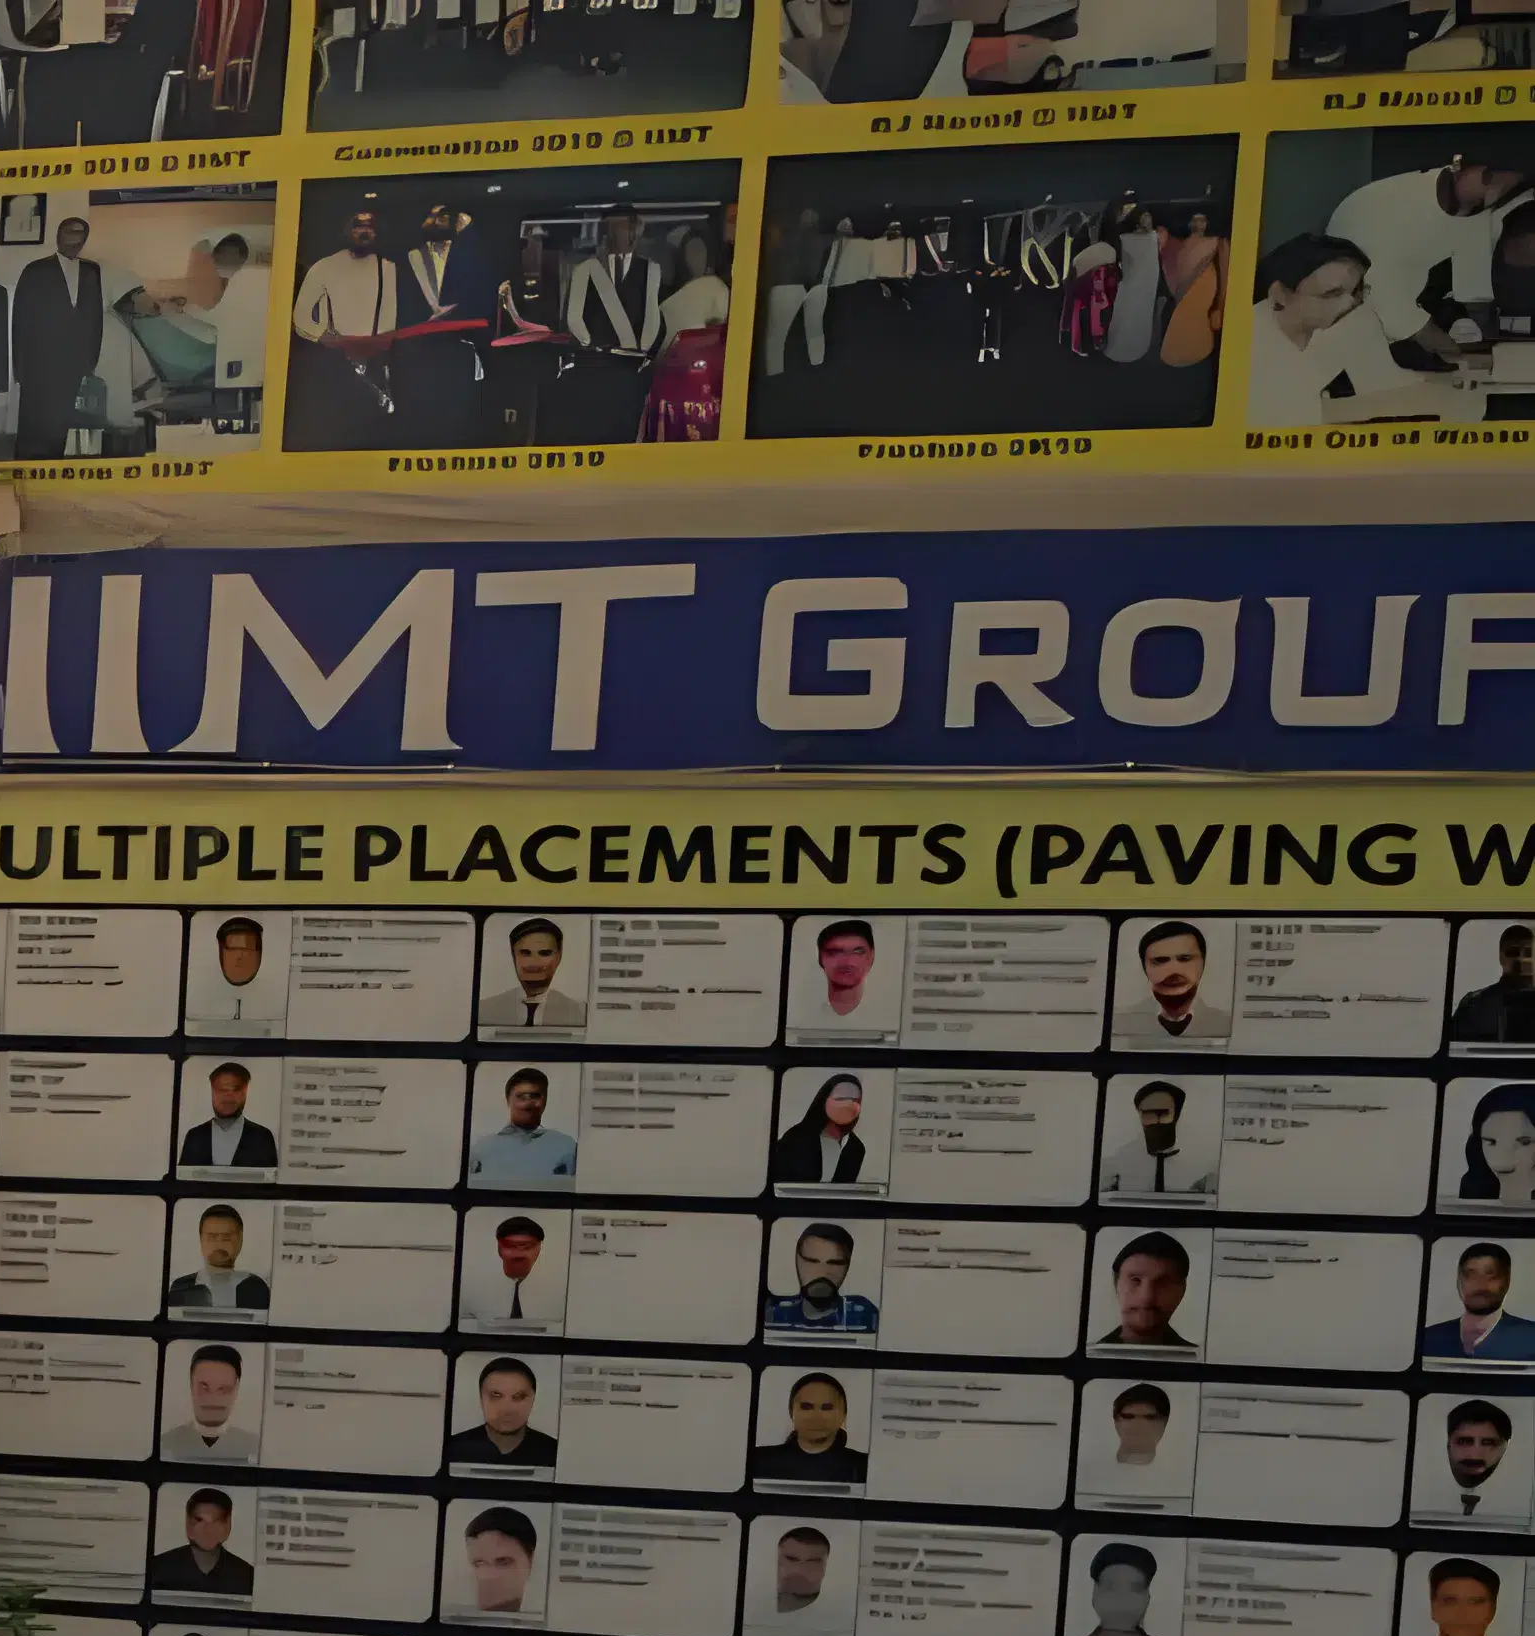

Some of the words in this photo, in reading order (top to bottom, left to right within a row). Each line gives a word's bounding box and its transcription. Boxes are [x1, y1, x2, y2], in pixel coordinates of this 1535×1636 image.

[2, 563, 696, 754] IIMT
[352, 824, 966, 886] PLACEMENTS
[996, 823, 1418, 899] (PAVING
